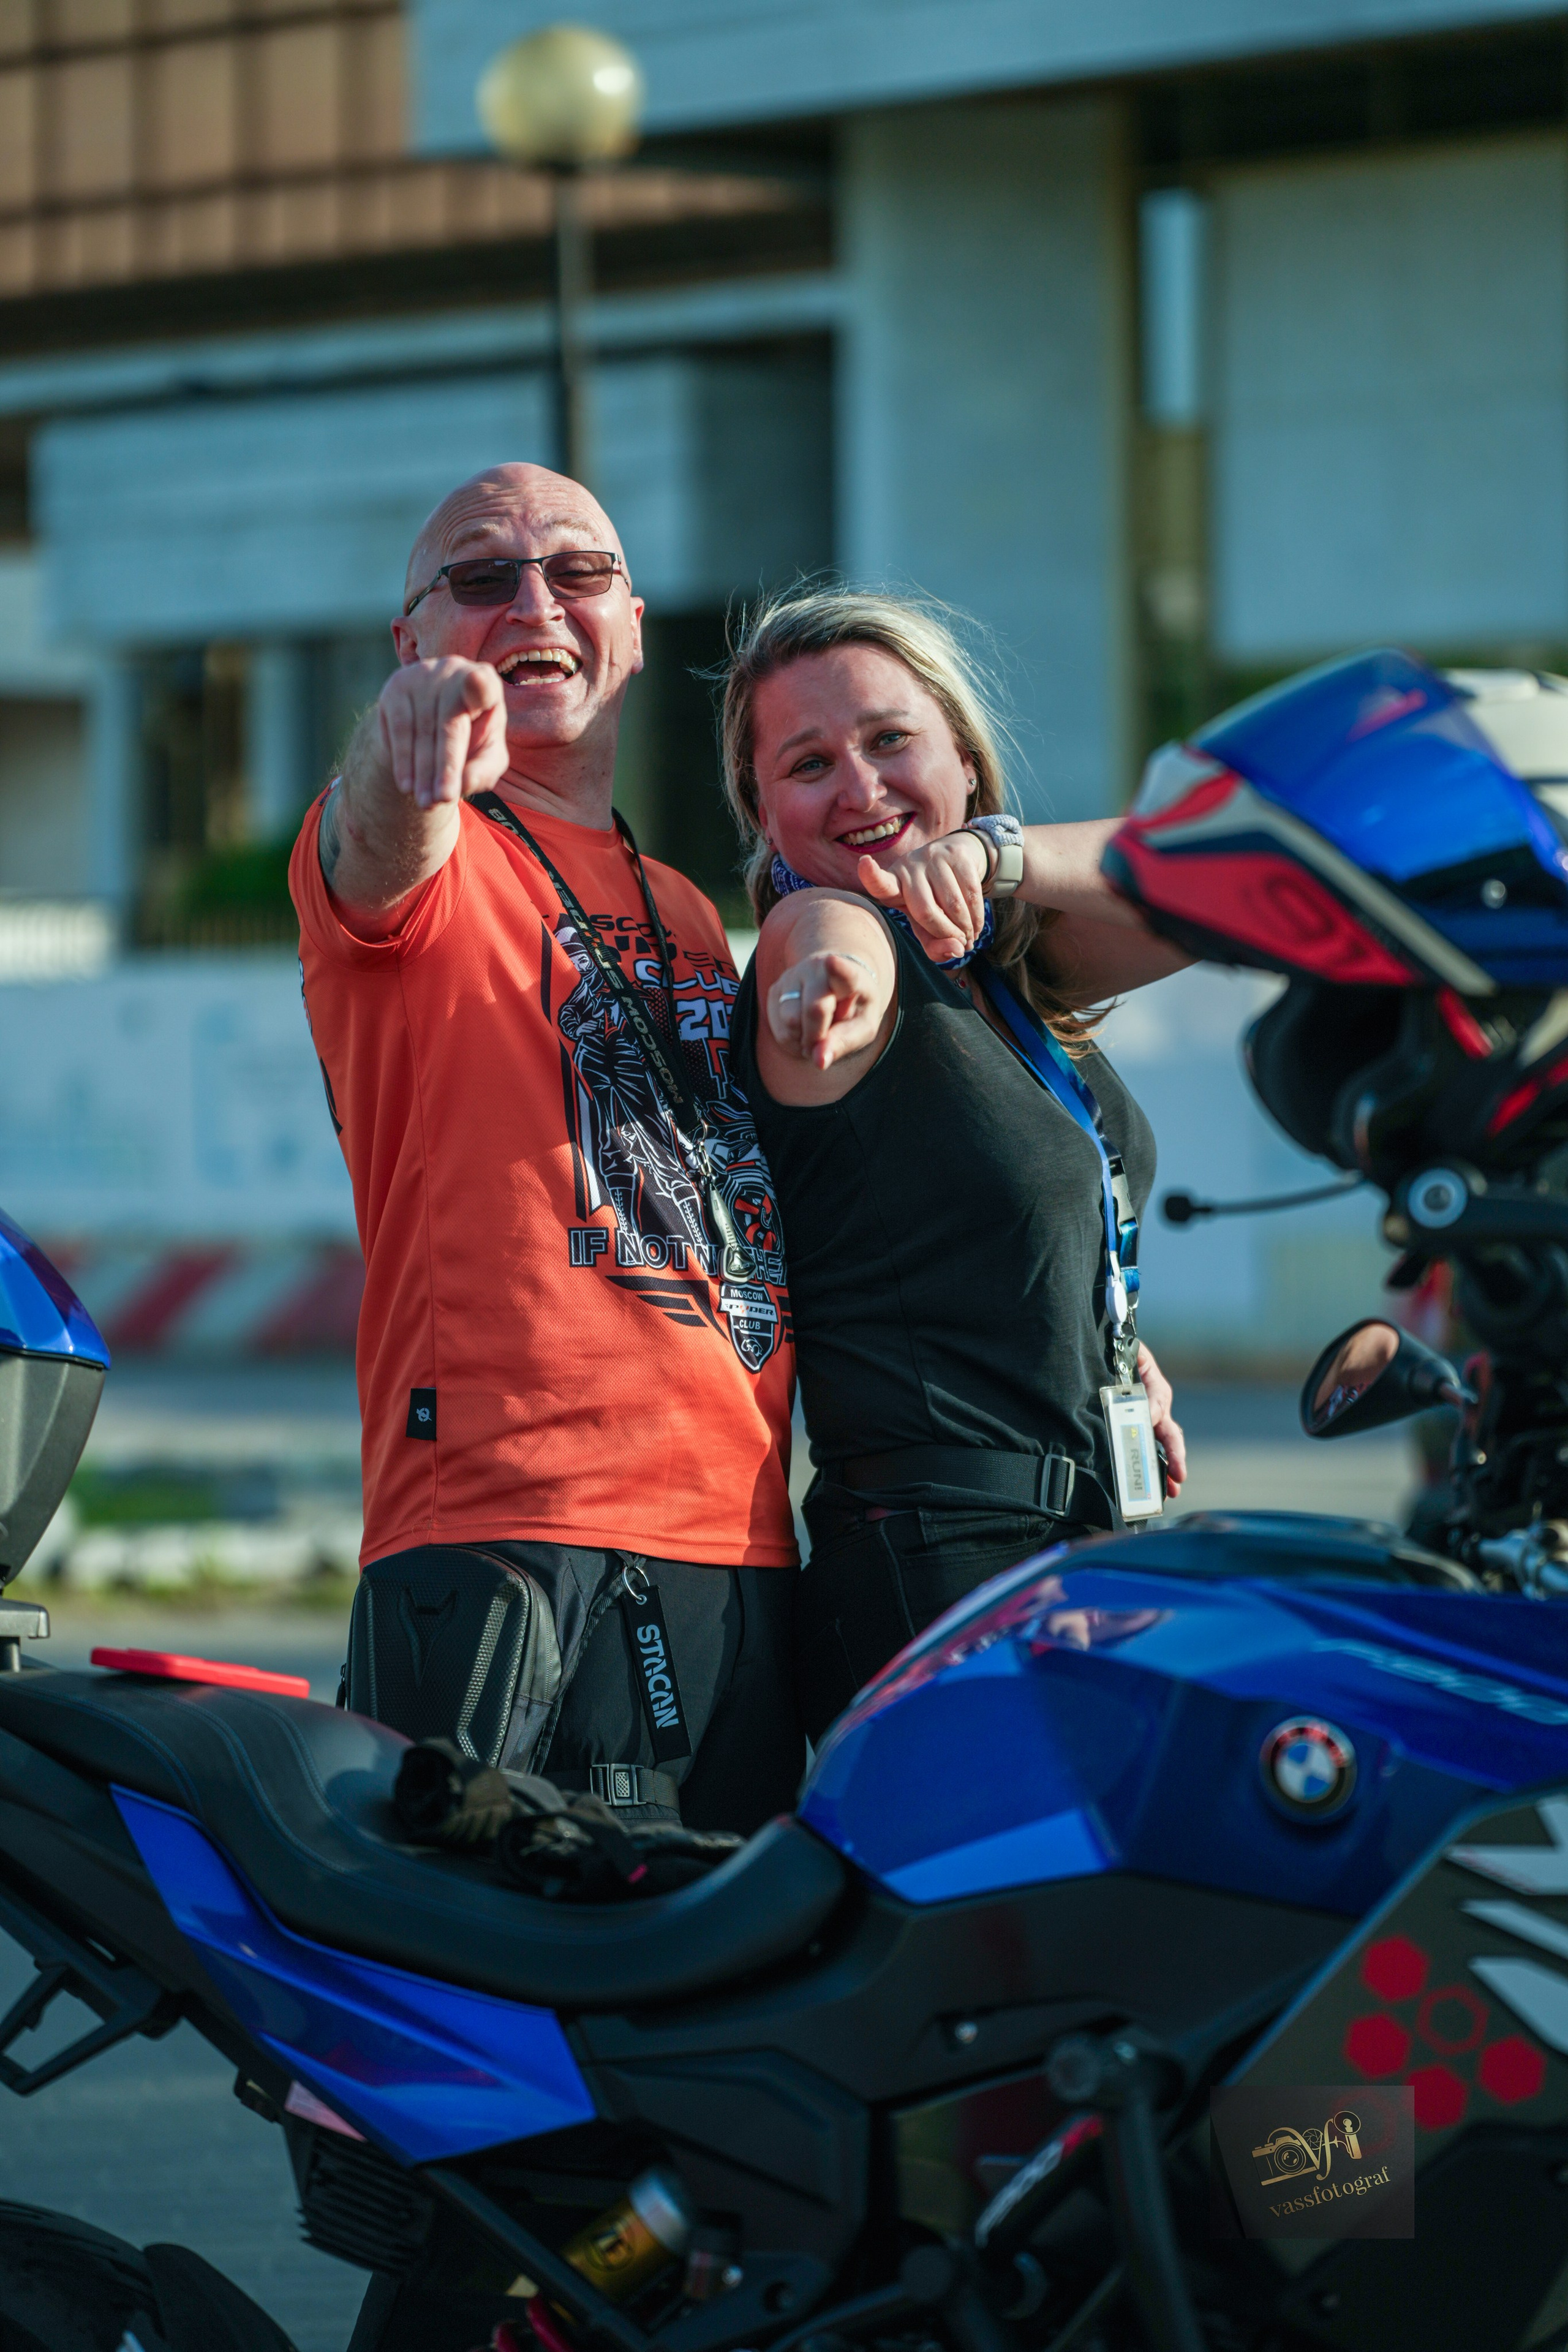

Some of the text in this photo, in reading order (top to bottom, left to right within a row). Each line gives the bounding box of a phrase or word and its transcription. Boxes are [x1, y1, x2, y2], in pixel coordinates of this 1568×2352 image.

[621, 996, 684, 1103] MOSCOW
[570, 1229, 608, 1266] IF
[617, 1229, 692, 1270] NOT
[730, 1289, 763, 1301] MOSCOW
[739, 1319, 761, 1330] CLUB
[637, 1624, 679, 1730] STACAN
